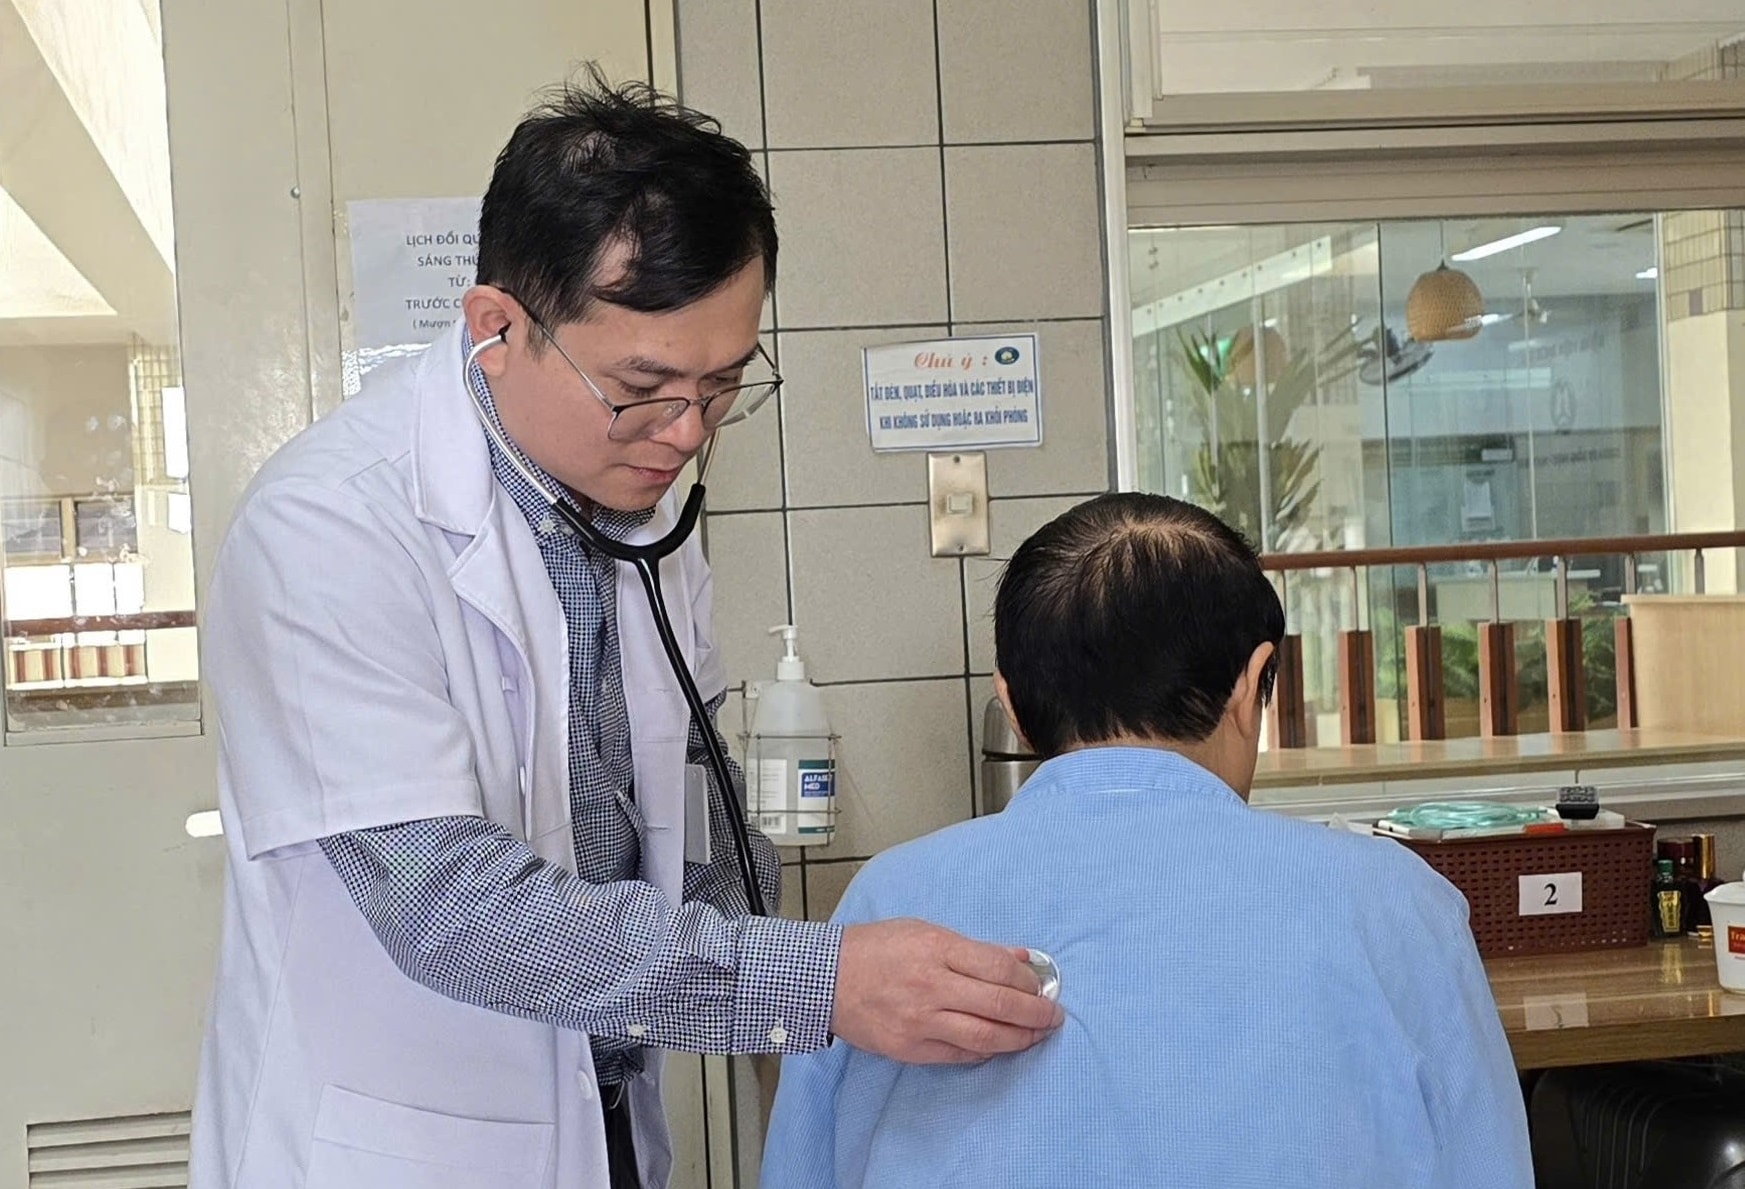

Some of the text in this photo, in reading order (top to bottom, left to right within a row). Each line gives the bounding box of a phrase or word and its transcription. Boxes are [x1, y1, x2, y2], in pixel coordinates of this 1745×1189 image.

[406, 234, 432, 247] LỊCH
[417, 253, 452, 267] SÁNG
[405, 297, 450, 310] TRƯỚC
[970, 378, 985, 396] CÁC
[1544, 883, 1558, 906] 2
